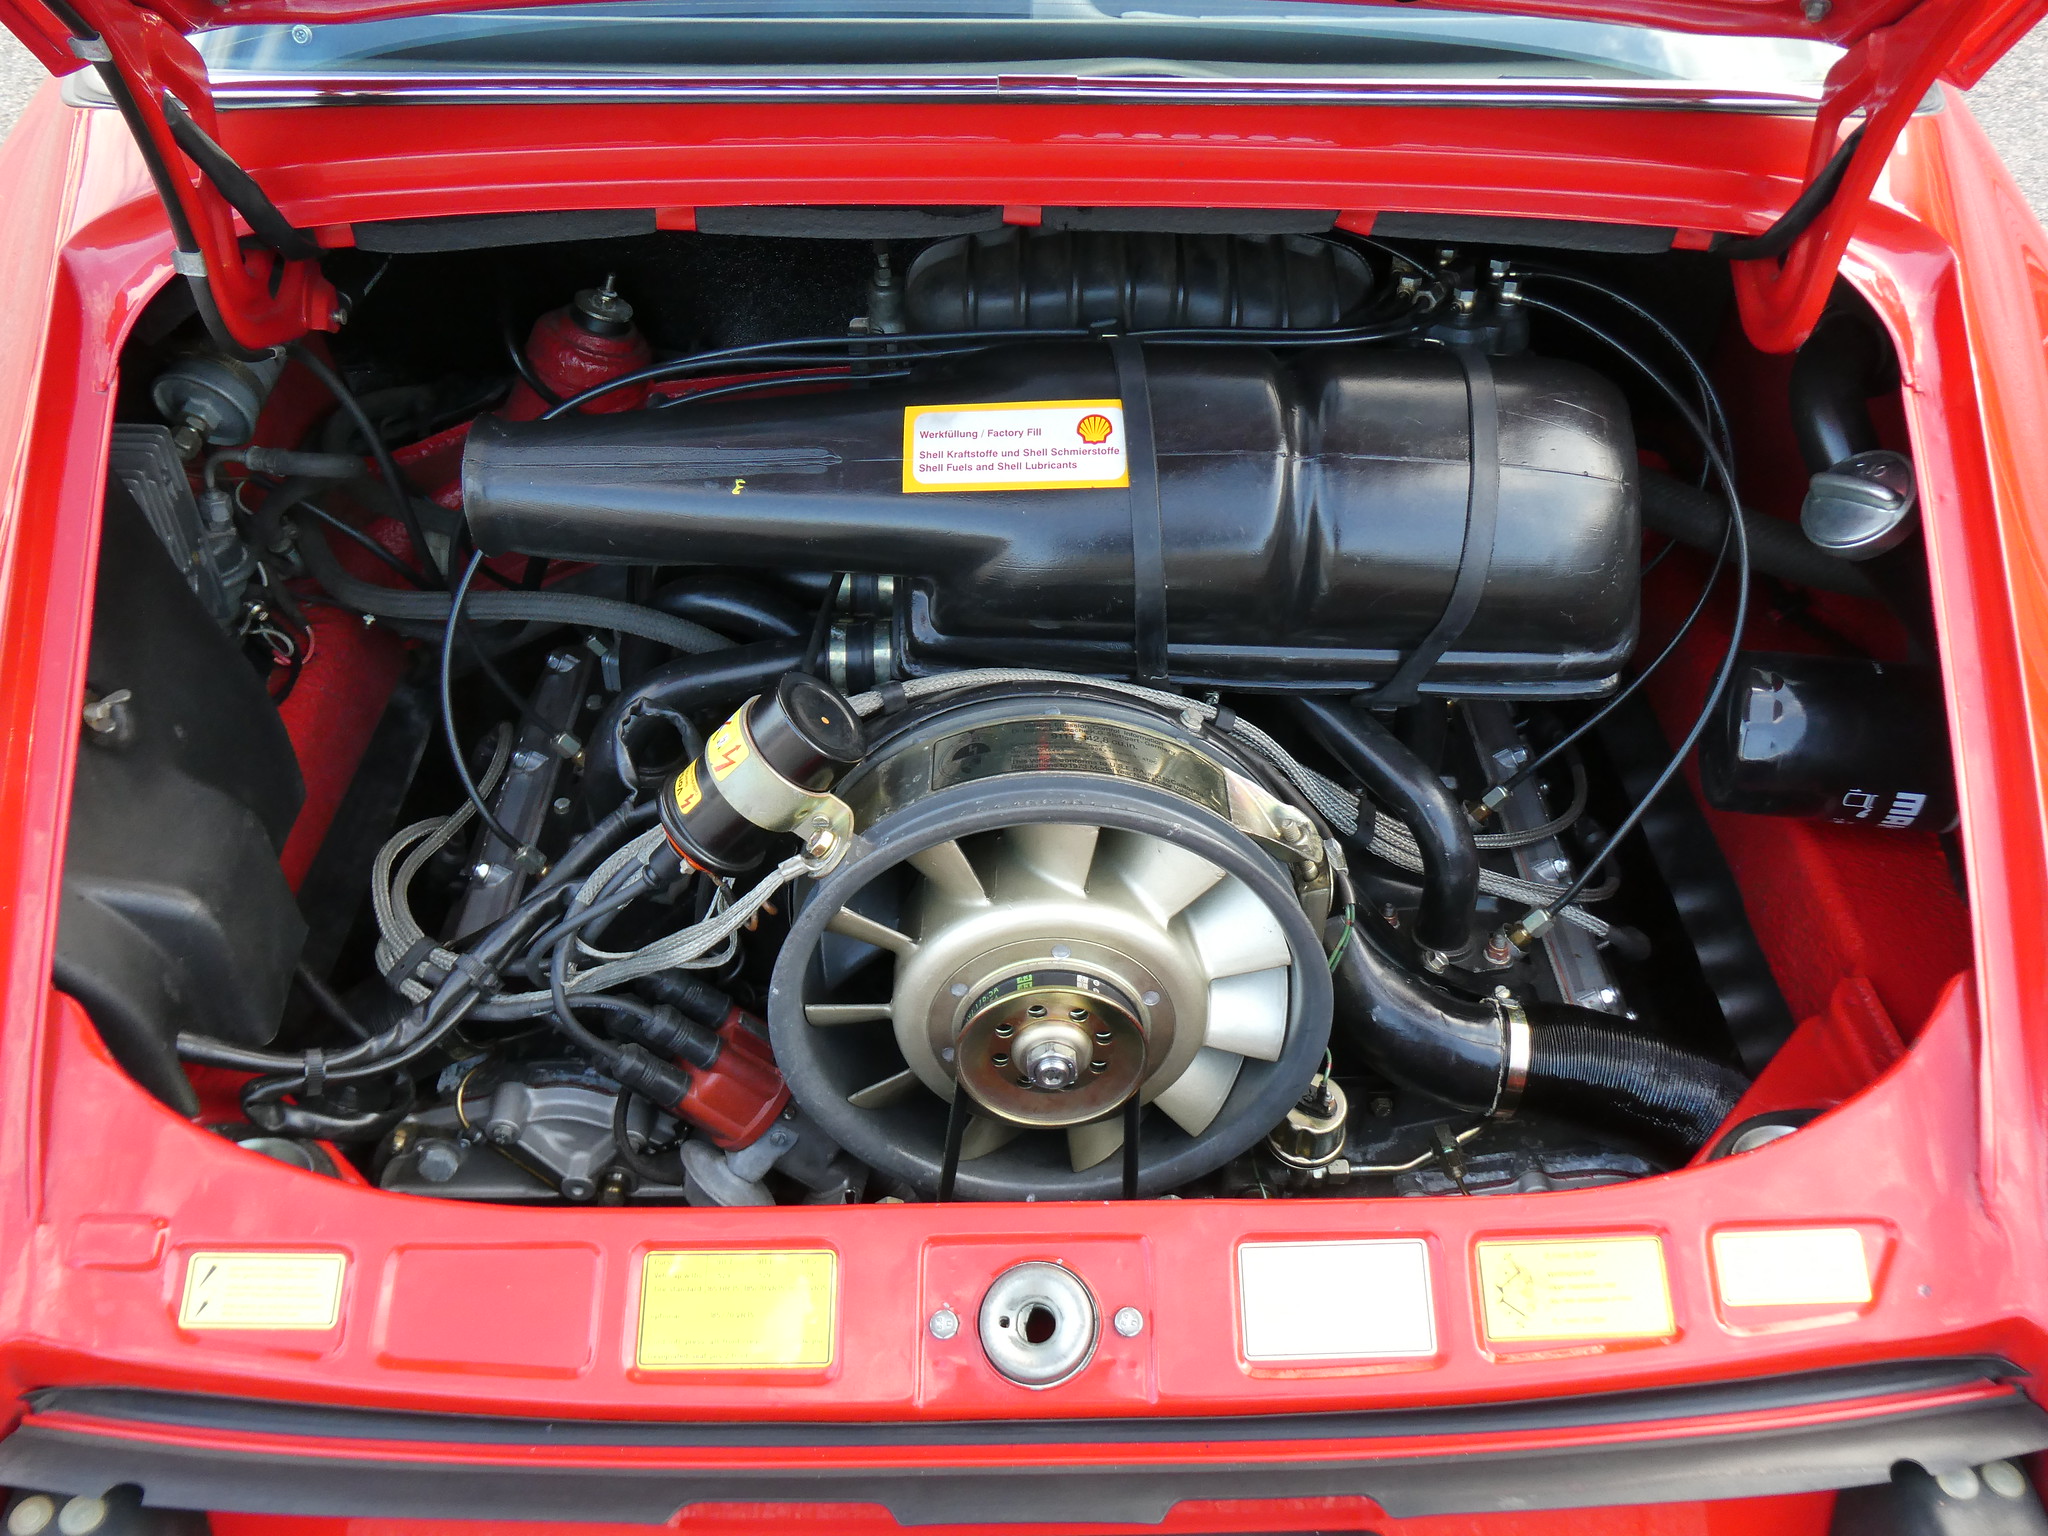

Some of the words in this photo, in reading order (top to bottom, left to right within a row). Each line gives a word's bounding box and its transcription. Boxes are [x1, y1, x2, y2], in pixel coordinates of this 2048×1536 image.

[919, 429, 978, 440] Werkfüllung
[987, 428, 1024, 439] Factory
[1026, 427, 1042, 437] Fill
[919, 450, 944, 459] Shell
[946, 450, 999, 459] Kraftstoffe
[1001, 448, 1020, 458] und
[1022, 448, 1048, 457] Shell
[1050, 446, 1120, 457] Schmierstoffe
[918, 463, 944, 473] Shell
[946, 463, 973, 472] Fuels
[975, 462, 995, 472] and
[997, 461, 1022, 471] Shell
[1025, 461, 1078, 470] Lubricants
[1092, 725, 1121, 733] Control
[1123, 730, 1164, 747] Information
